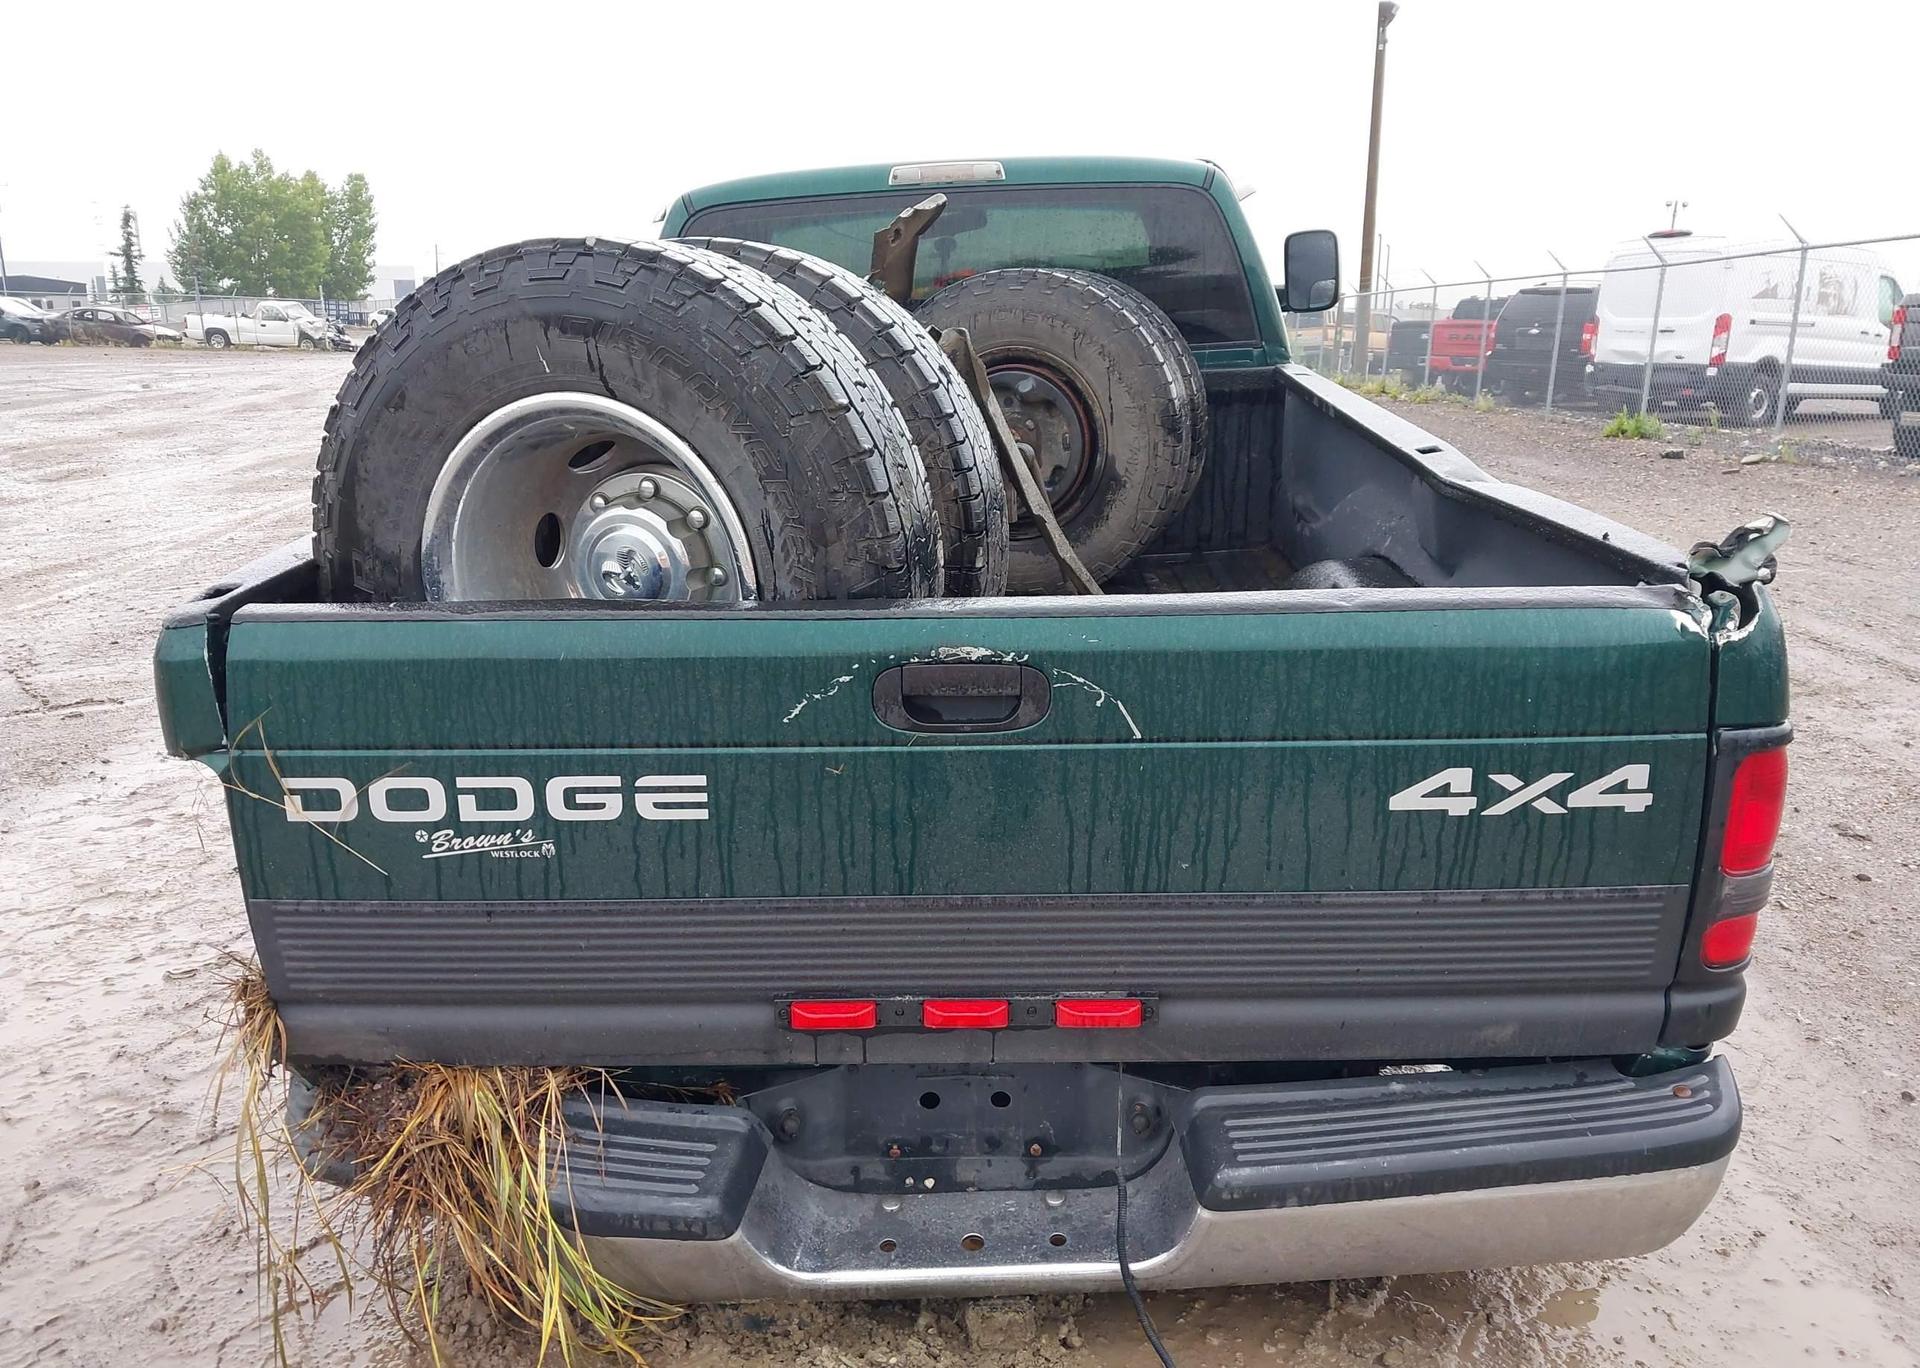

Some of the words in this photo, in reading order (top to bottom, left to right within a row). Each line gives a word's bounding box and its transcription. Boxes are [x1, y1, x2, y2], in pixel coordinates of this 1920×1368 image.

[283, 774, 709, 821] DODGE
[430, 828, 536, 852] Brown's
[490, 850, 541, 858] WESTLOCK
